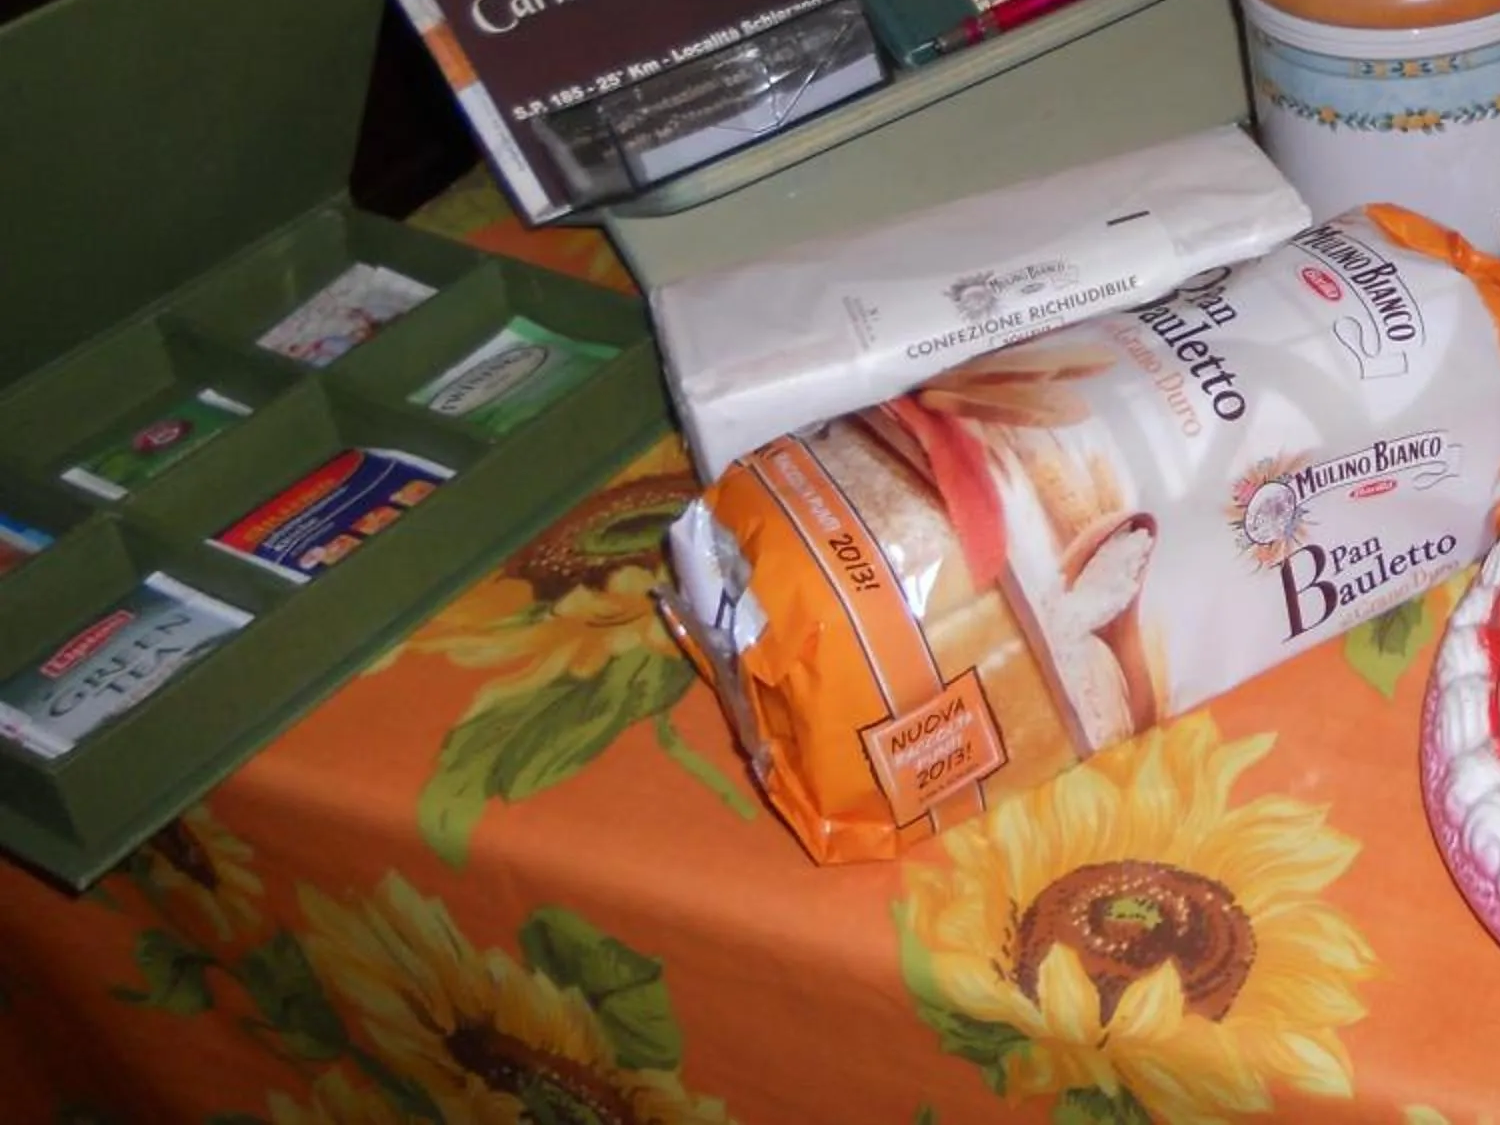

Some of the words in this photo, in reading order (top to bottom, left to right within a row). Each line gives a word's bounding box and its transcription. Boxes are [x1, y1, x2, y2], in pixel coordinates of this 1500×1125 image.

[627, 59, 662, 81] Km
[1304, 225, 1370, 273] MULINO
[1361, 261, 1417, 342] BIANCO
[906, 311, 1023, 359] CONFEZIONE
[1028, 274, 1139, 322] RICHIUDIBILE
[1155, 372, 1203, 437] Duro
[1296, 455, 1371, 500] MULINO
[1373, 436, 1442, 473] BIANCO
[829, 533, 881, 593] 2013!
[1330, 536, 1382, 575] Pan
[1279, 533, 1458, 644] Bauletto
[49, 612, 192, 718] GREEN
[95, 647, 183, 697] TEA
[889, 696, 967, 755] NUOVA
[915, 744, 973, 791] 2013!
